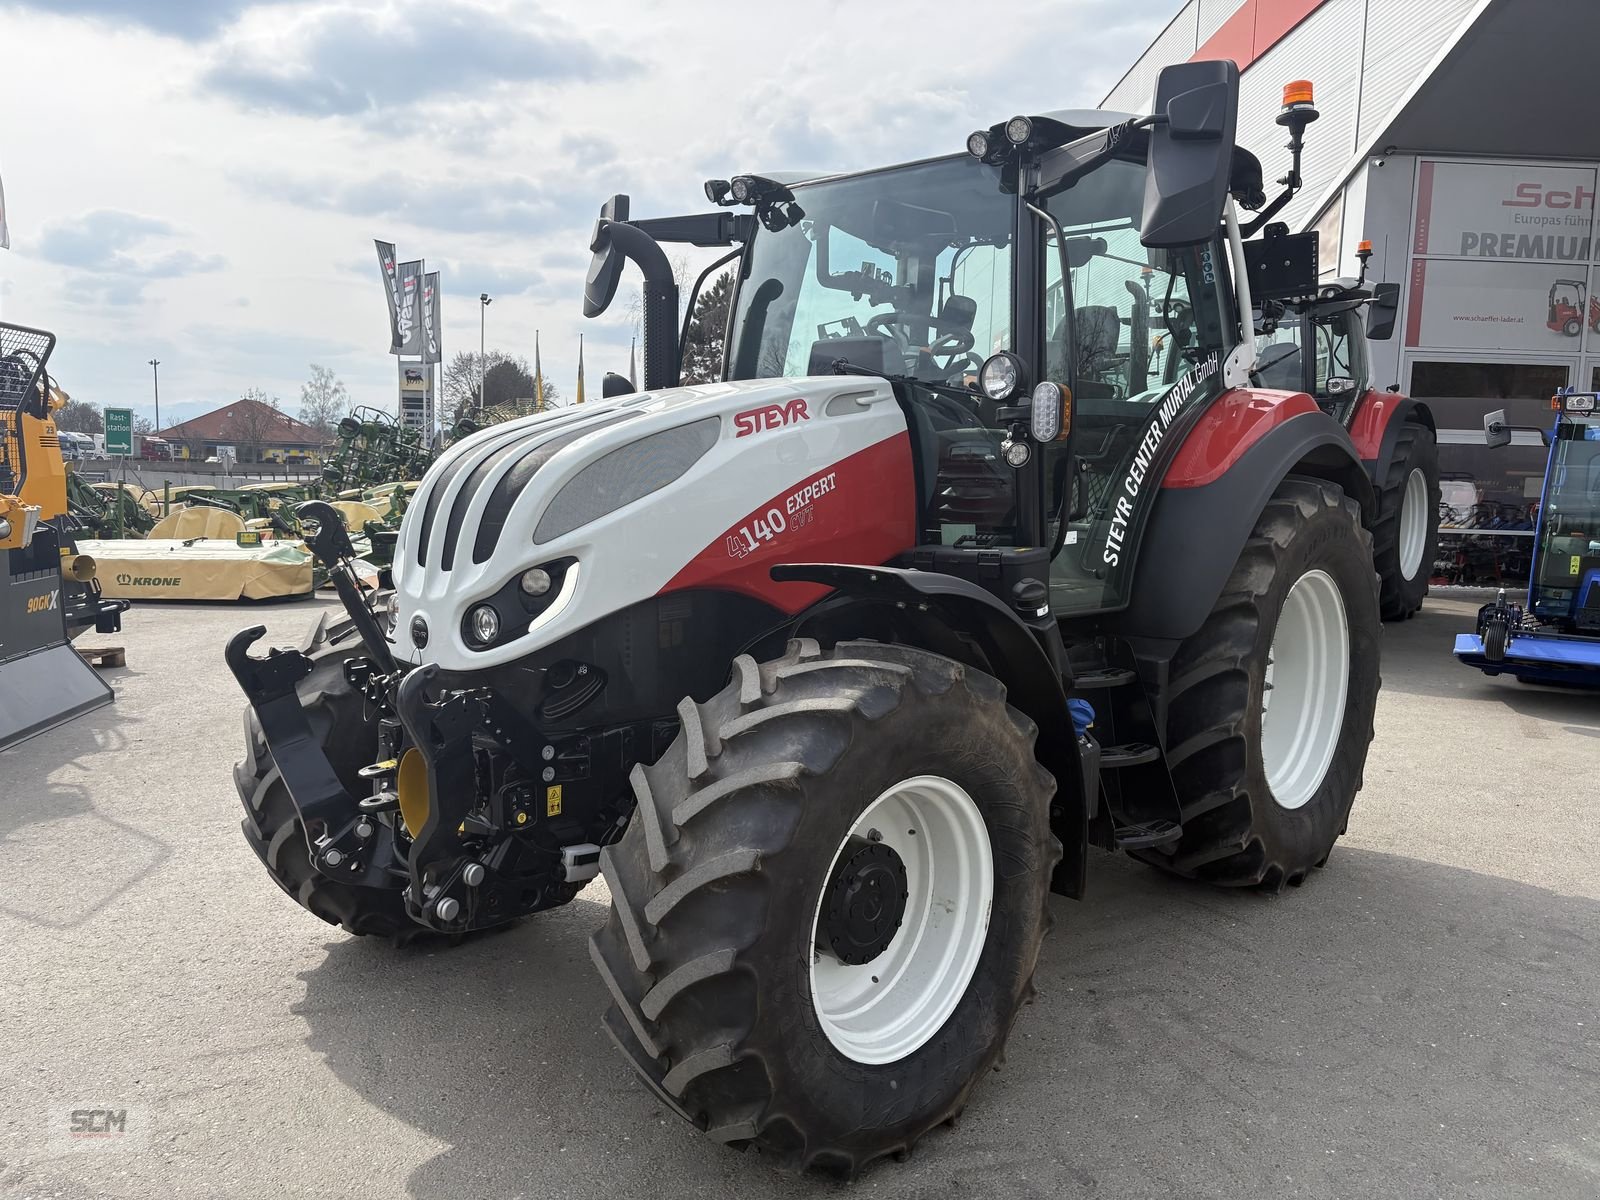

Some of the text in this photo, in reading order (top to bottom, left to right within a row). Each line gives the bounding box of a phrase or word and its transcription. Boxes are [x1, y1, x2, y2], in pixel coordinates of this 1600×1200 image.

[1514, 213, 1600, 228] Europas führ
[107, 423, 131, 432] station
[109, 413, 127, 421] Rast-
[733, 398, 810, 439] STEYR
[1103, 351, 1219, 567] STEYR CENTER MURTAL GmbH
[726, 472, 836, 559] 4140 EXPERT
[790, 504, 814, 532] CVT
[132, 577, 182, 586] KRONE
